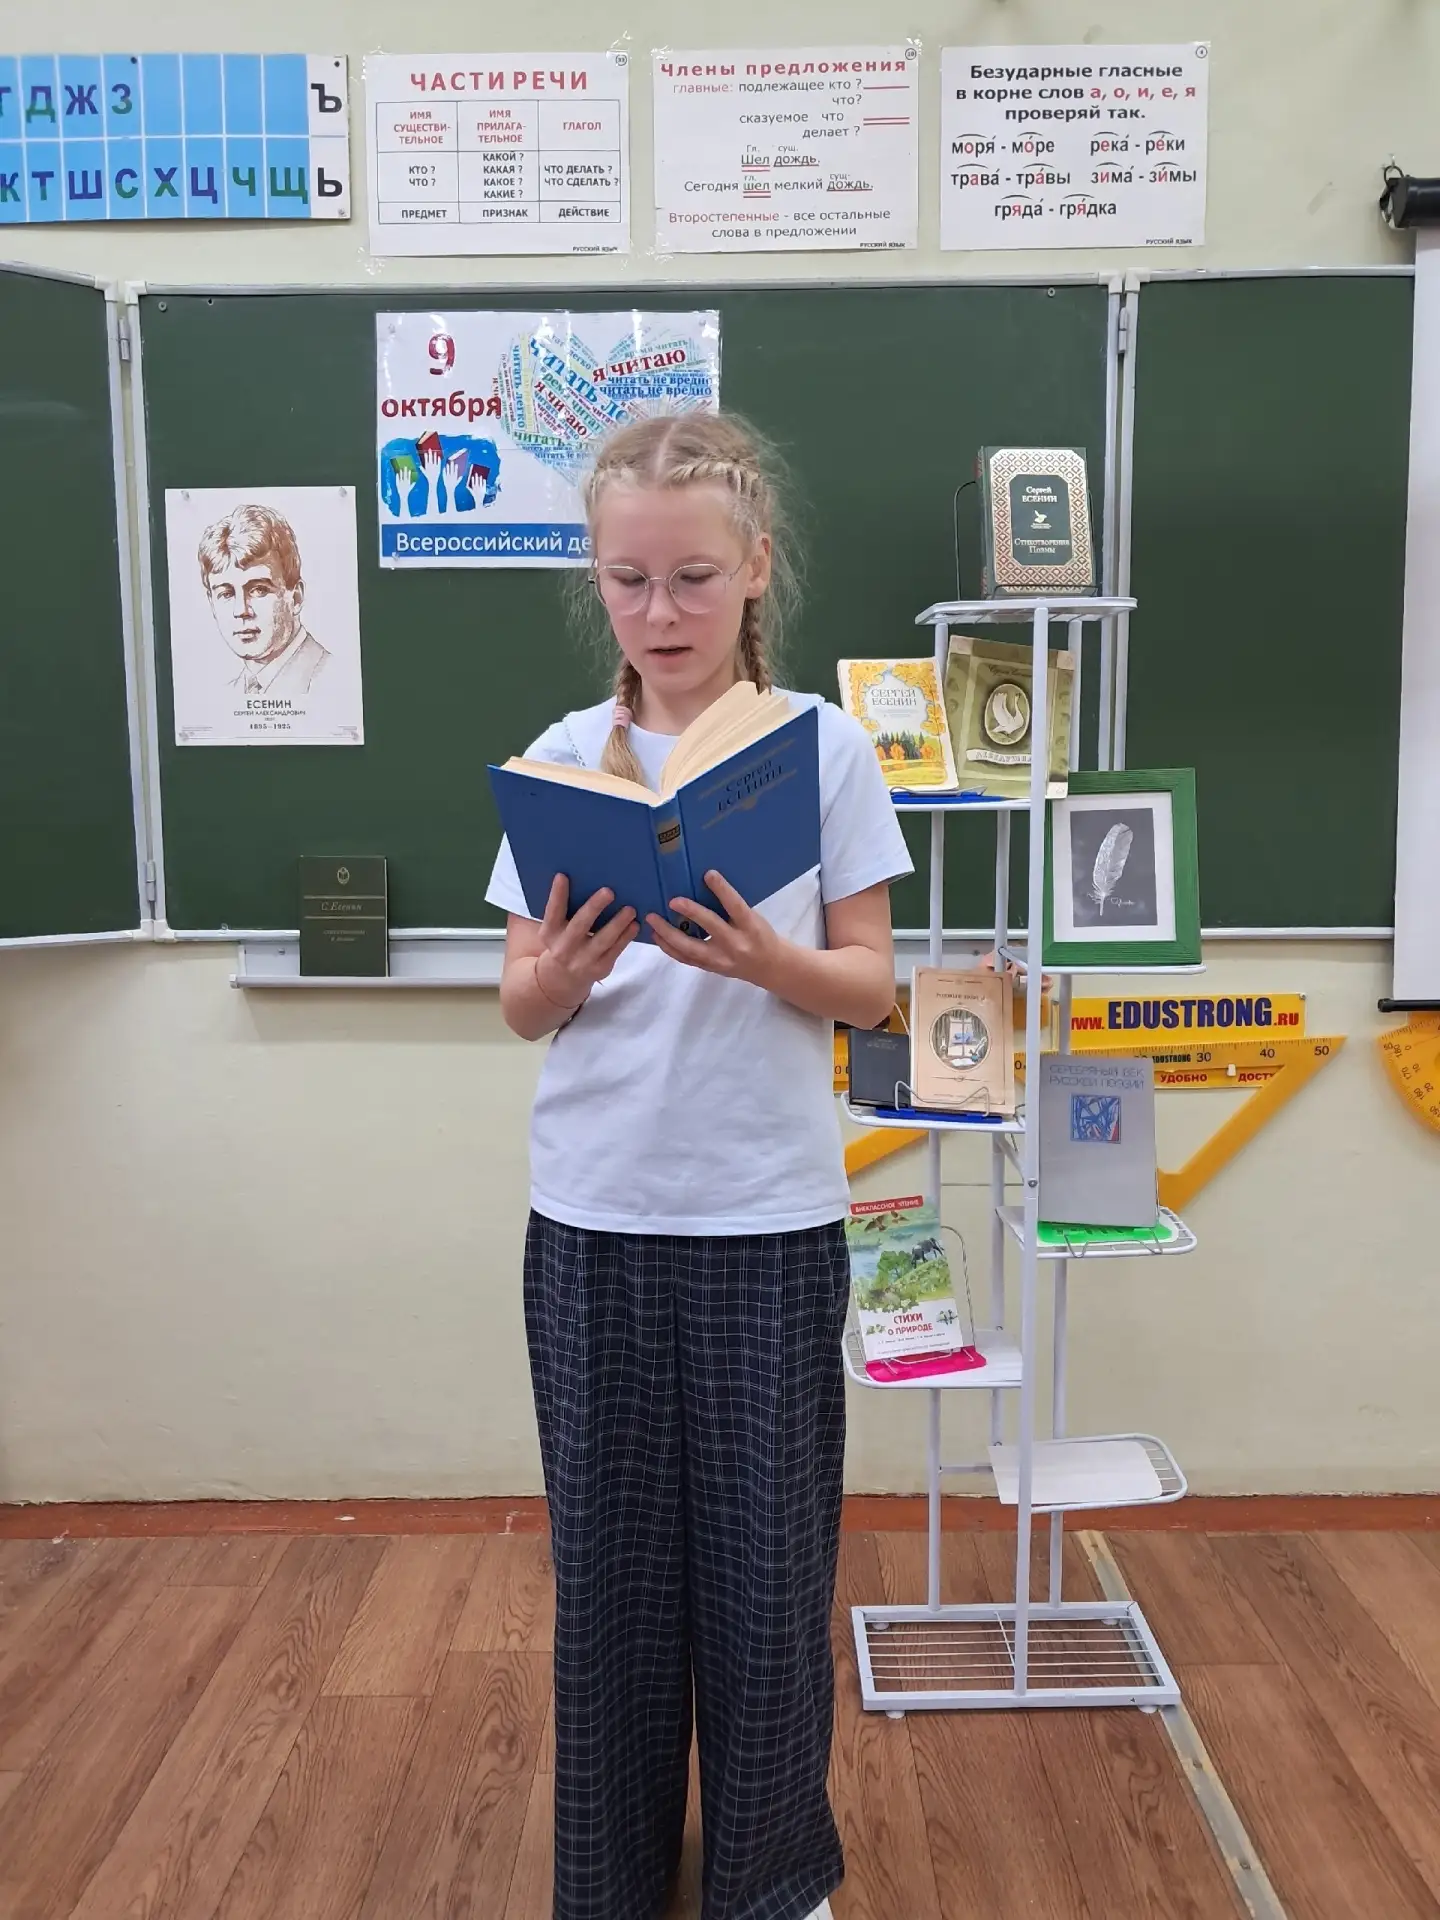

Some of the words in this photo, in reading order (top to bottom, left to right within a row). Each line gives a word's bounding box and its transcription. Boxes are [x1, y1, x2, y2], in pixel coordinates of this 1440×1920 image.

[660, 62, 735, 77] Члены
[746, 60, 906, 78] предложения
[970, 65, 1093, 81] Безударные
[1099, 66, 1183, 78] гласные
[410, 72, 505, 91] ЧАСТИ
[513, 71, 588, 90] РЕЧИ
[673, 82, 733, 94] главные:
[739, 81, 825, 93] подлежащее
[829, 81, 851, 90] кто
[956, 89, 966, 100] в
[973, 87, 1033, 102] корне
[1038, 87, 1084, 99] слов
[1184, 86, 1195, 97] я
[25, 85, 56, 123] Д
[64, 84, 99, 115] Ж
[311, 83, 342, 113] Ъ
[489, 110, 511, 118] ИМЯ
[739, 113, 809, 124] сказуемое
[822, 112, 844, 121] что
[1005, 106, 1101, 123] проверяй
[1107, 108, 1146, 119] так.
[394, 123, 451, 134] СУЩЕСТВИ-
[477, 122, 527, 132] ПРИЛАГА-
[563, 122, 602, 131] ГЛАГОЛ
[478, 135, 523, 143] ТЕЛЬНОЕ
[802, 128, 849, 139] делает
[399, 136, 444, 145] ТЕЛЬНОЕ
[483, 151, 516, 162] КАКОЙ
[741, 155, 770, 164] Шел
[774, 154, 820, 167] дождь.
[409, 166, 428, 175] КТО
[483, 165, 515, 174] КАКАЯ
[544, 165, 564, 174] ЧТО
[566, 165, 605, 175] ДЕЛАТЬ
[0, 172, 21, 202] К
[31, 171, 54, 200] Т
[68, 170, 103, 200] Ш
[115, 168, 139, 198] С
[154, 167, 179, 197] Х
[191, 167, 218, 204] Ц
[232, 167, 255, 197] Ч
[270, 167, 308, 204] Щ
[317, 167, 343, 197] Ь
[409, 178, 428, 187] ЧТО
[483, 178, 515, 187] КАКОЕ
[544, 178, 564, 186] ЧТО
[566, 178, 611, 187] СДЕЛАТЬ
[684, 181, 739, 193] Сегодня
[743, 181, 770, 191] шел
[774, 178, 823, 190] мелкий
[827, 178, 874, 191] дождь.
[484, 190, 516, 199] КАКИЕ
[401, 209, 447, 219] ПРЕДМЕТ
[482, 209, 528, 218] ПРИЗНАК
[558, 206, 610, 218] ДЕЙСТВИЕ
[669, 212, 779, 225] Второстепенные
[794, 211, 816, 221] все
[820, 210, 891, 220] остальные
[712, 228, 750, 238] слова
[754, 228, 761, 237] в
[766, 226, 857, 238] предложении
[428, 333, 456, 376] 9
[592, 368, 606, 383] я
[610, 349, 686, 377] читаю
[381, 390, 502, 422] октября
[396, 531, 563, 557] Всероссийский
[567, 537, 592, 556] де
[247, 700, 292, 709] ЕСЕНИН
[872, 698, 917, 706] ЕСЕНИН
[1196, 1052, 1211, 1062] 30
[1259, 1048, 1275, 1058] 40
[1314, 1045, 1330, 1056] 50
[1123, 1067, 1144, 1077] ВЕК
[1160, 1074, 1208, 1083] УДОБНО
[894, 1313, 923, 1324] СТИХИ
[896, 1323, 933, 1335] ПРИРОДЕ
